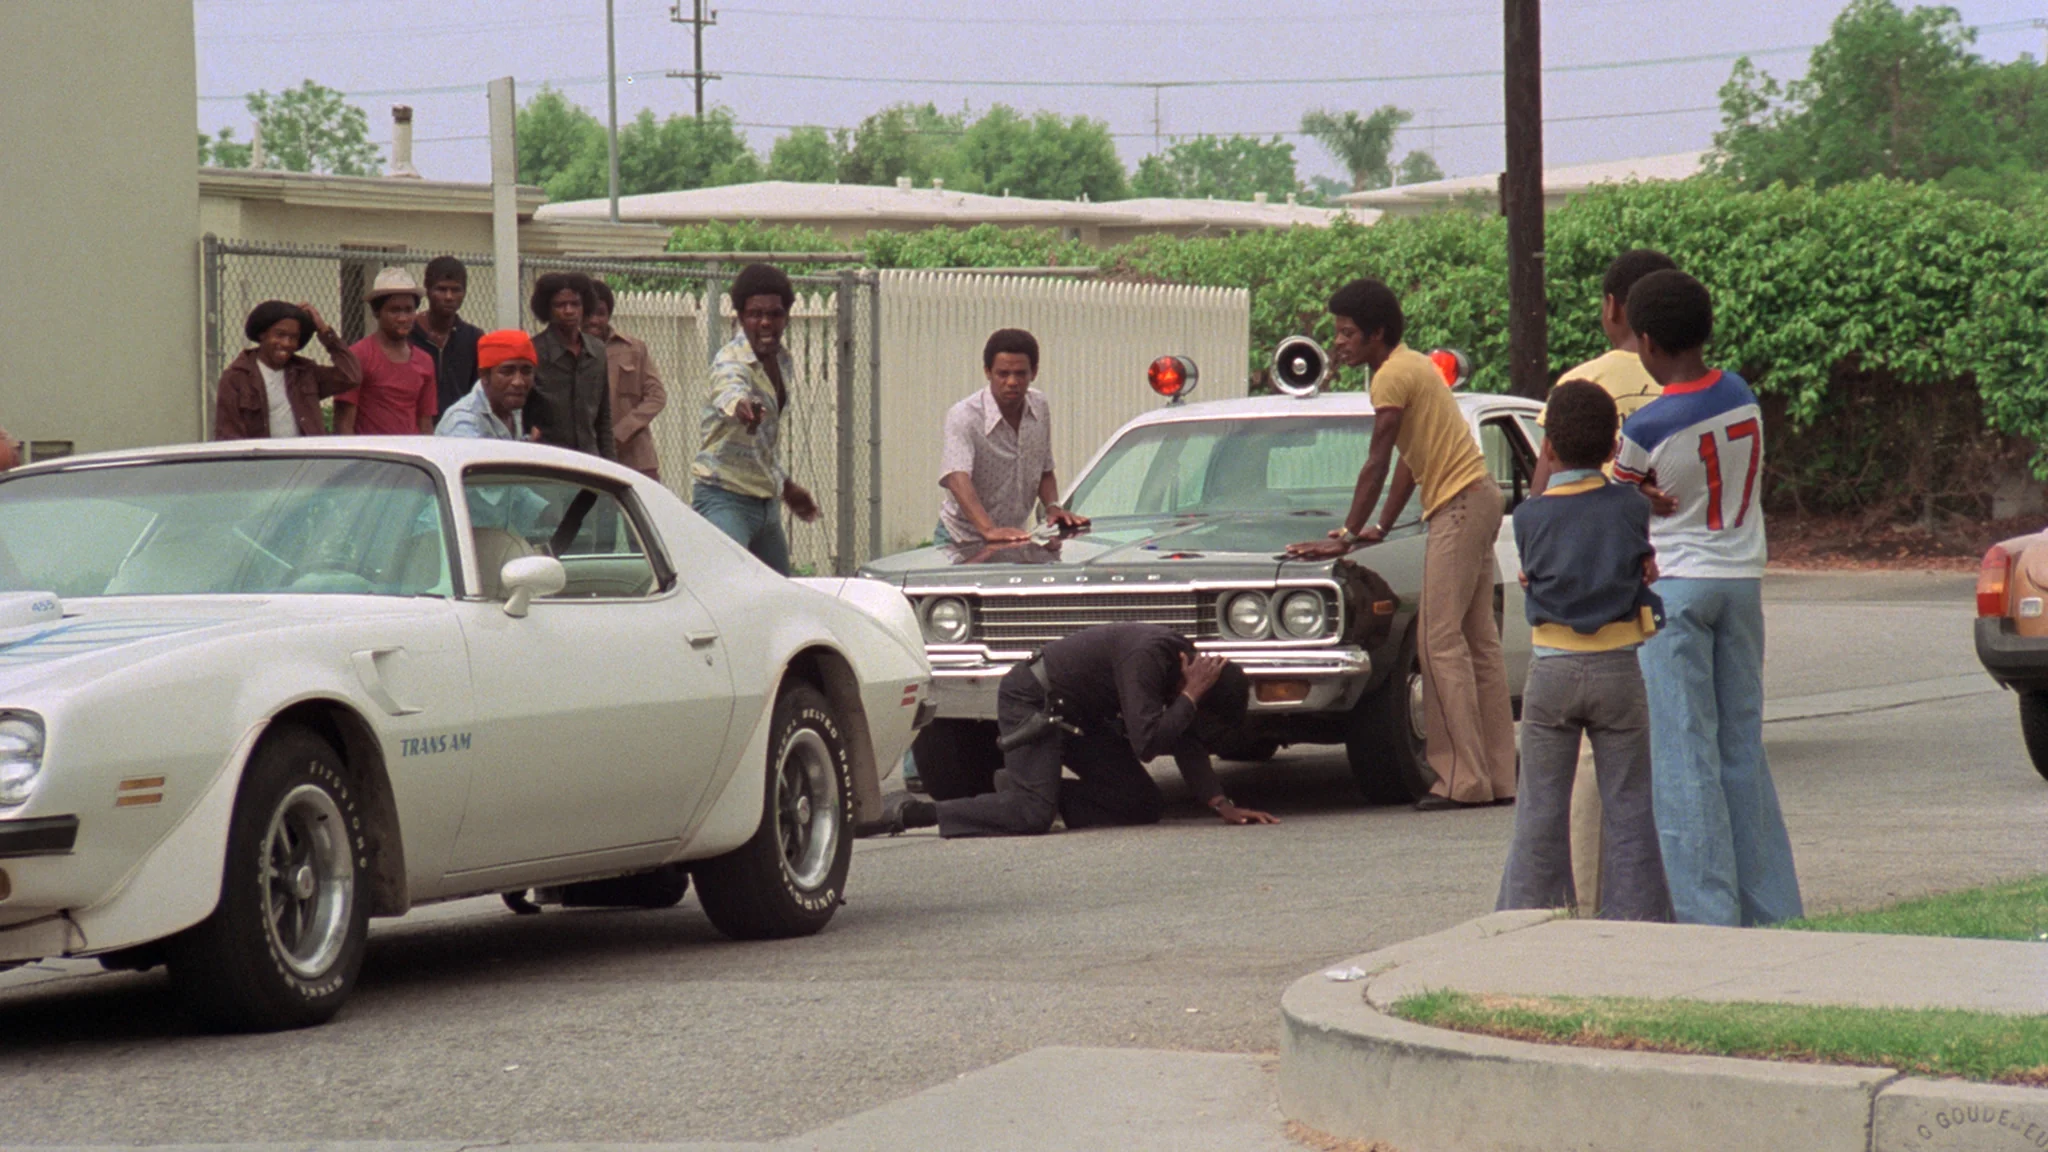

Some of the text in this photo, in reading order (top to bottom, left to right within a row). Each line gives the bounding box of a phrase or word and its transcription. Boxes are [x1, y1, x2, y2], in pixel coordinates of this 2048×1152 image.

[1698, 416, 1761, 531] 17
[1009, 574, 1161, 584] DODGE
[31, 599, 55, 612] 455
[400, 732, 472, 757] TRANS AM
[802, 708, 838, 739] BELTED
[839, 749, 853, 822] RADIAL
[779, 861, 836, 910] UNIROYAL
